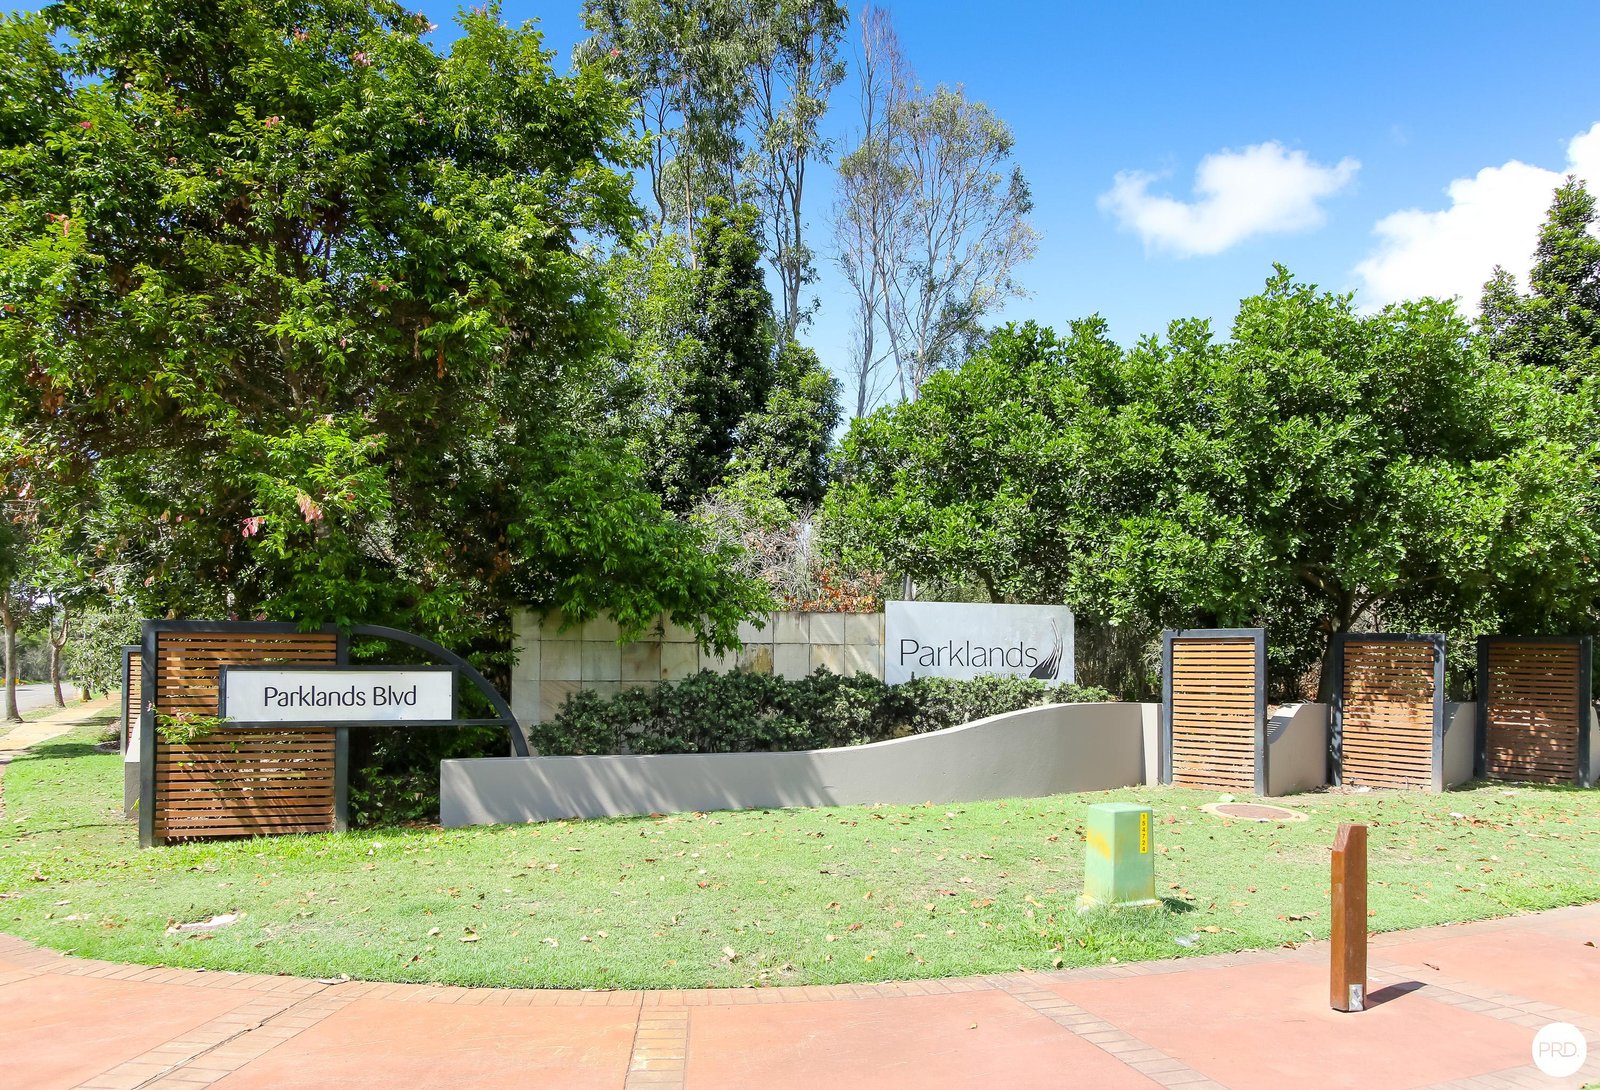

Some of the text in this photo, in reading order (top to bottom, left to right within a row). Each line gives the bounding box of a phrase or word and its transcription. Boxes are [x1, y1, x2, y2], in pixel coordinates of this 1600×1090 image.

[900, 638, 1038, 668] Parklands
[264, 685, 417, 707] Parklands Blvd
